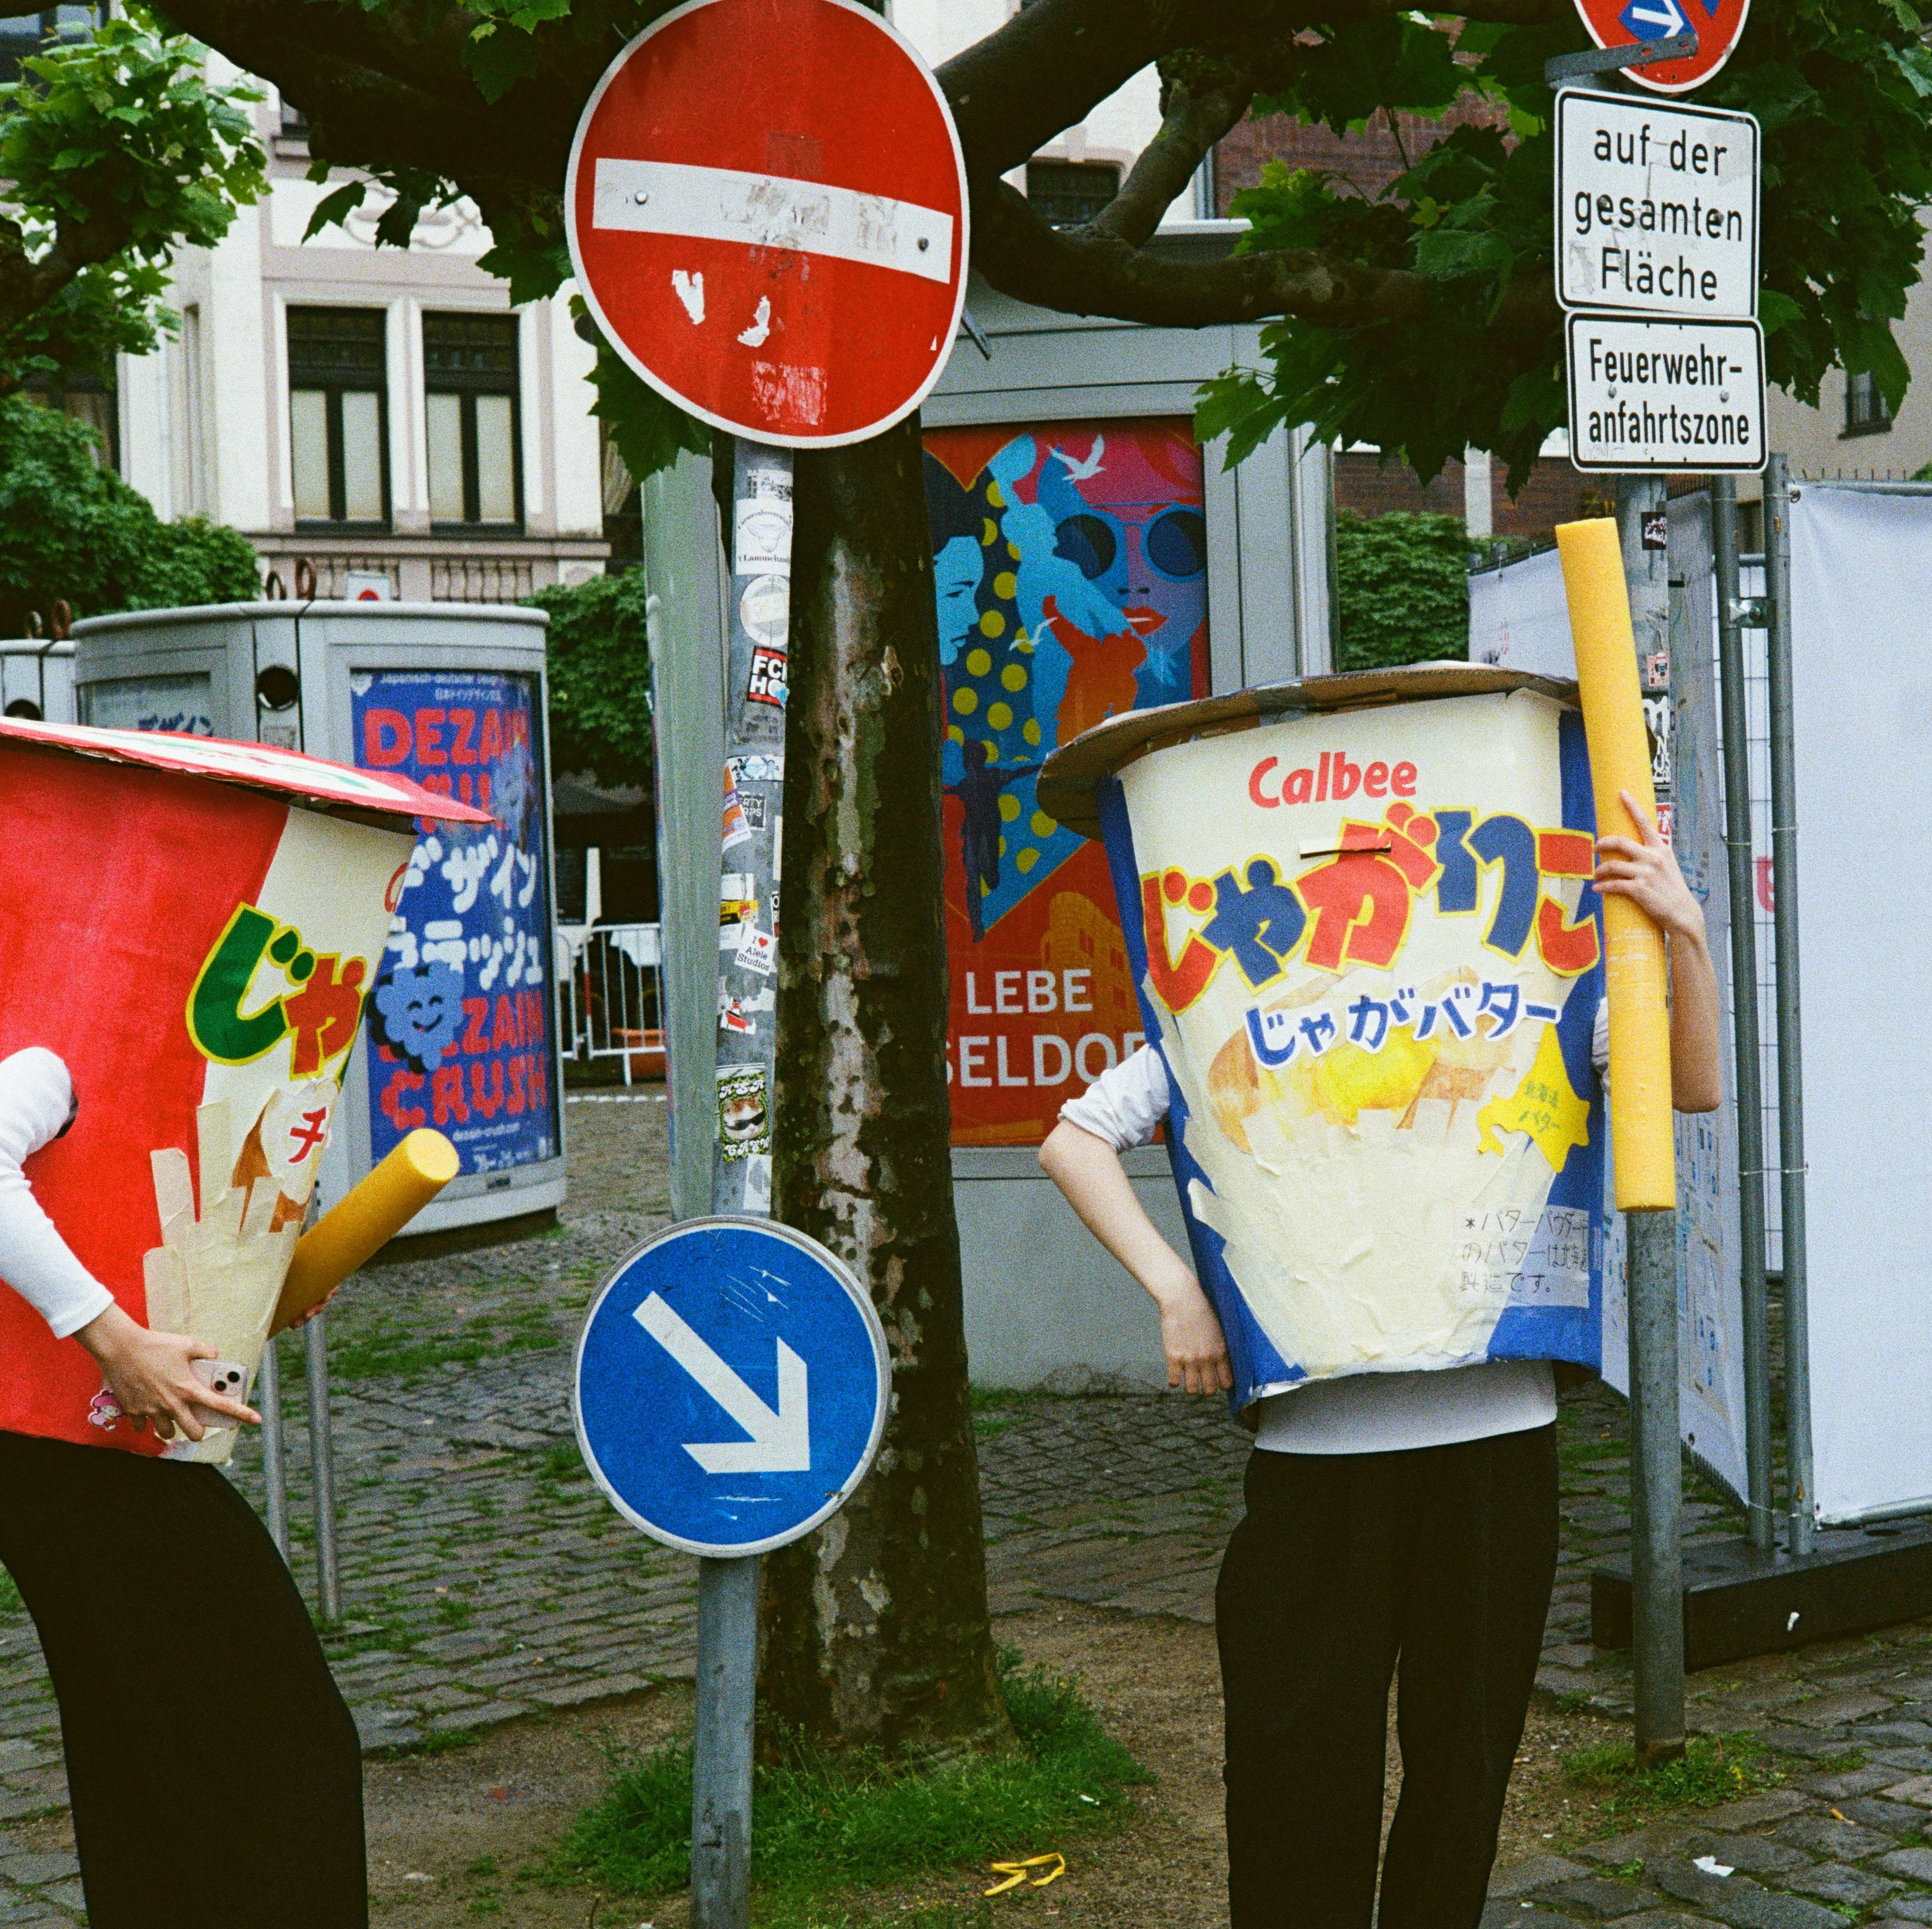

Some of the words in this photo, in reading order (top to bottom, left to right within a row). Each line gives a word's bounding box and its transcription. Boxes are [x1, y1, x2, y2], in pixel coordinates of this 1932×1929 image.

[1594, 125, 1650, 166] auf
[1670, 130, 1727, 176] der
[1575, 192, 1742, 241] gesamten
[1602, 247, 1717, 301] Fläche
[1590, 339, 1742, 385] Feuerwehr-
[1589, 401, 1749, 445] anfahrtszone
[1249, 752, 1418, 809] Calbee
[1139, 800, 1601, 1015] じゃがりこ
[966, 969, 1093, 1014] LEBE
[1248, 982, 1557, 1066] じゃがバター
[946, 1031, 1146, 1087] ELDO
[380, 1052, 547, 1130] CRUSH
